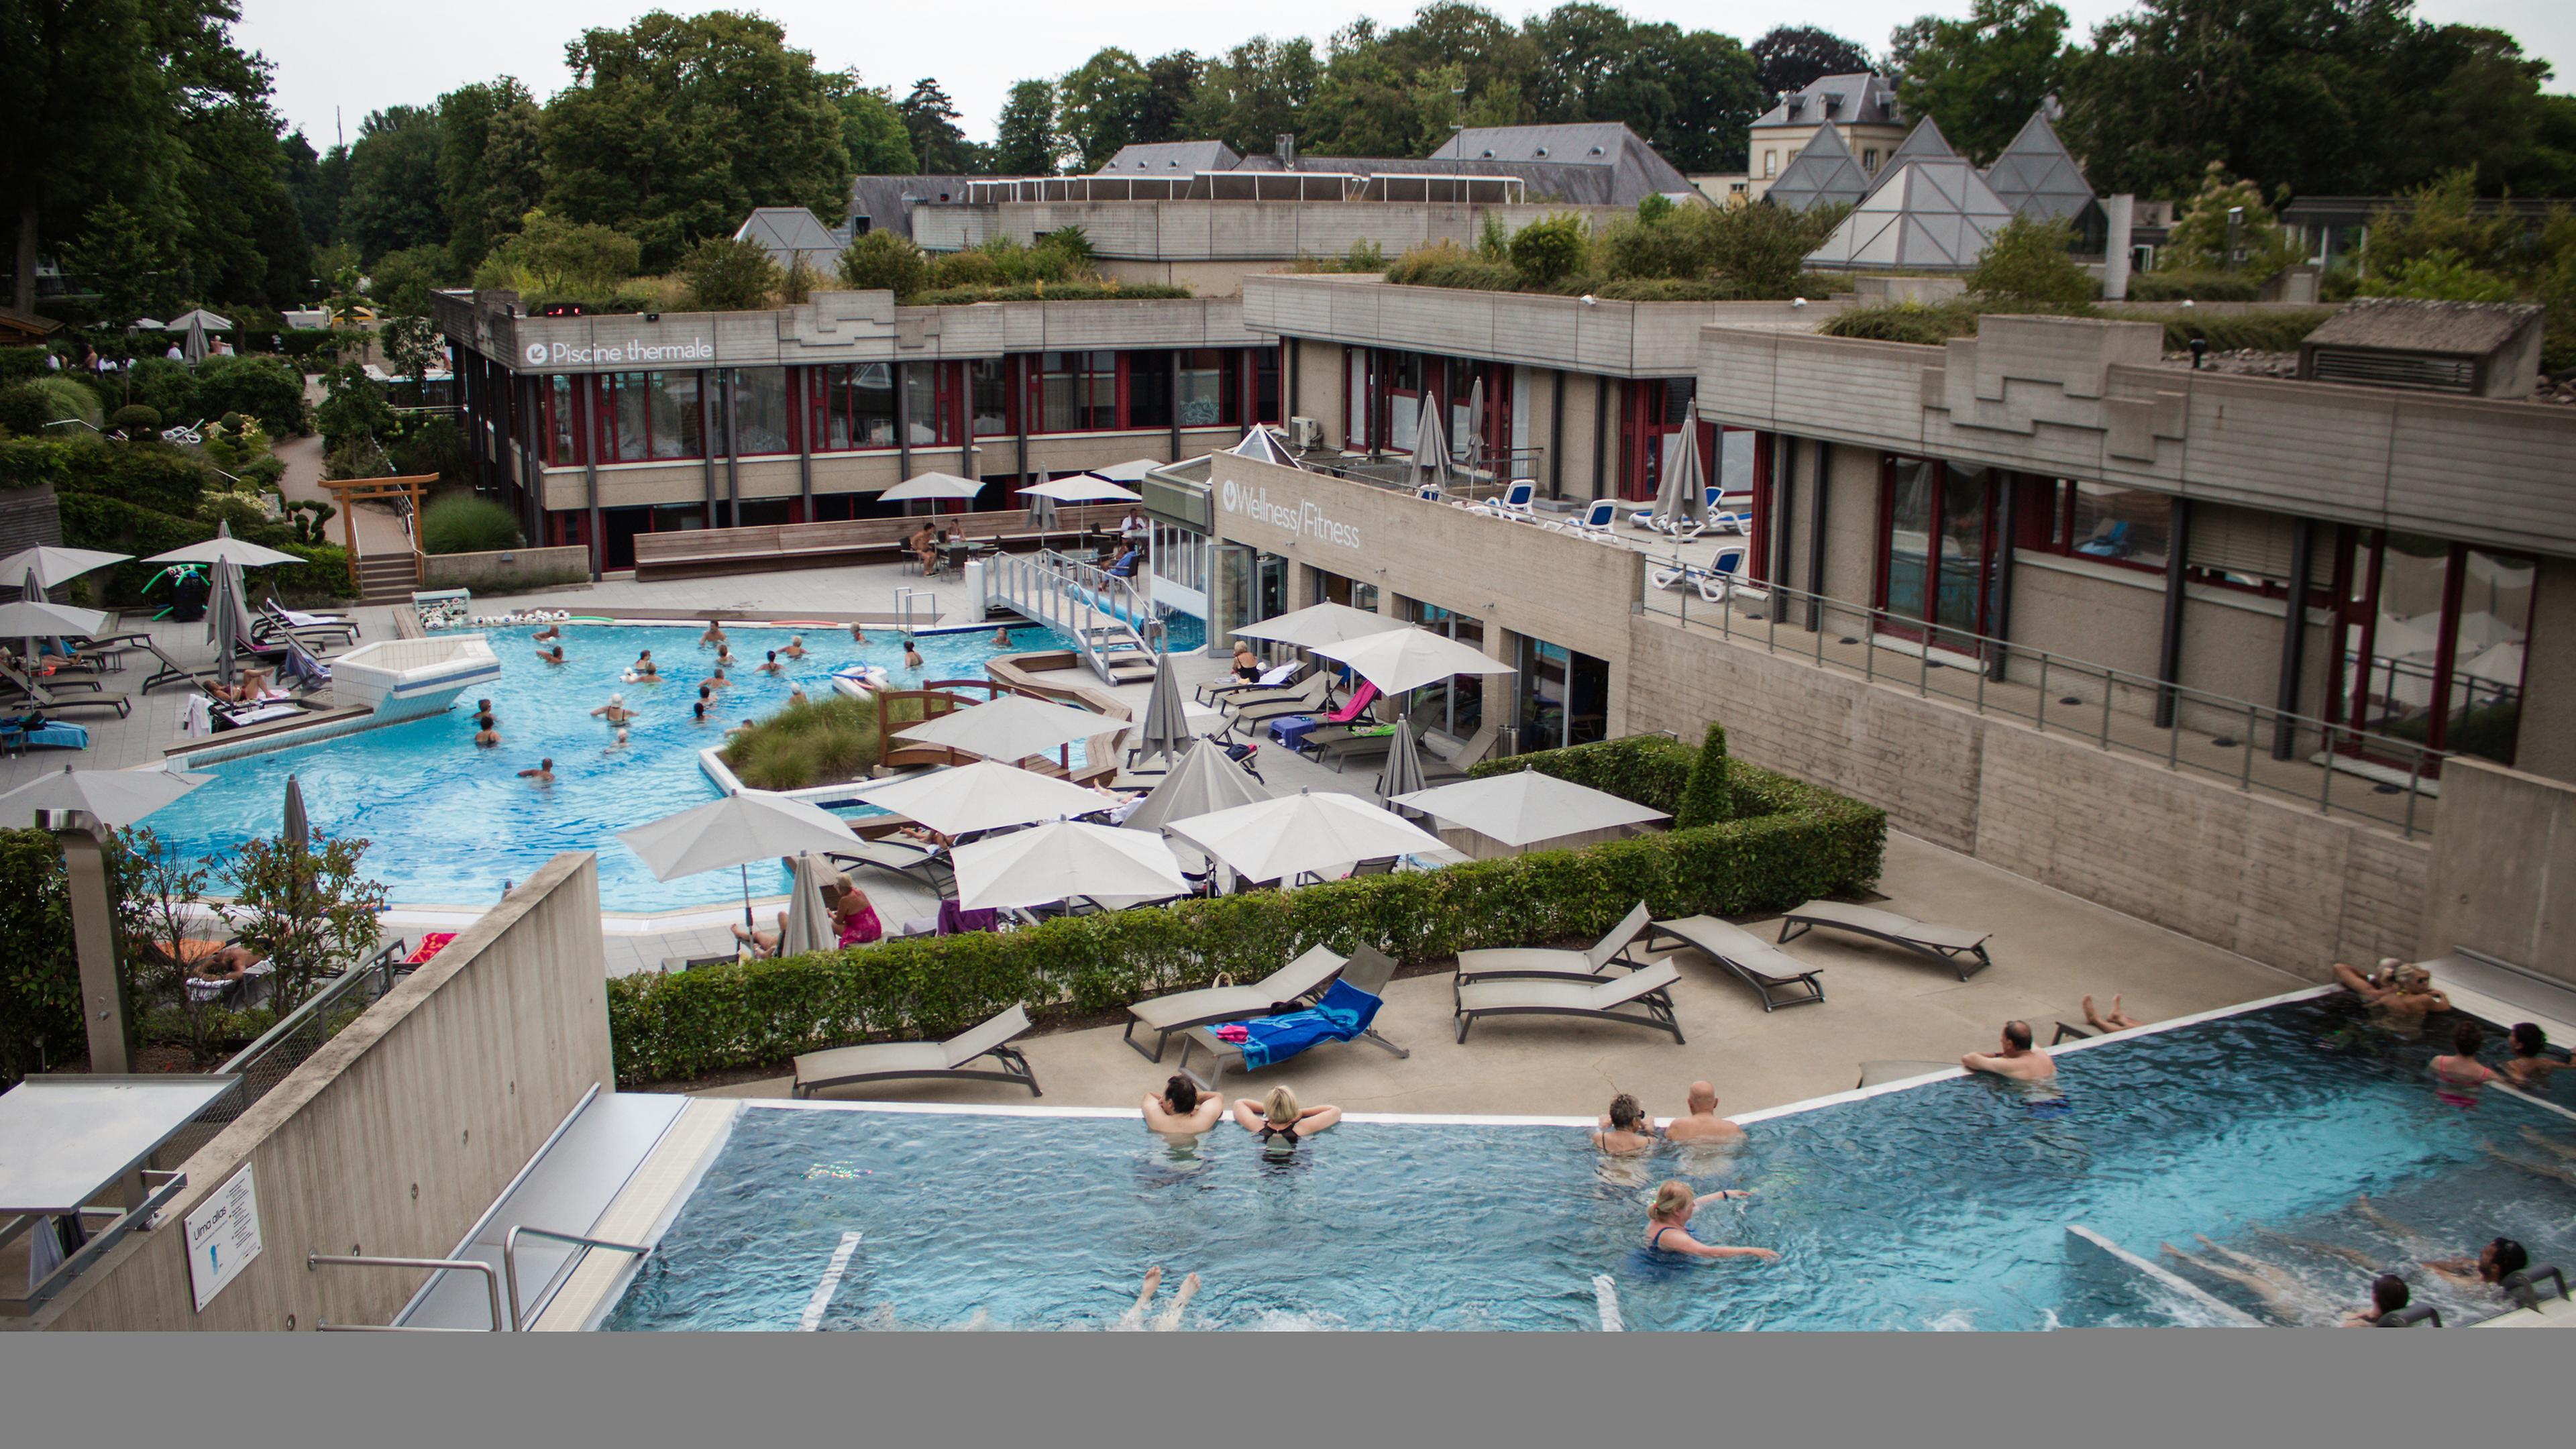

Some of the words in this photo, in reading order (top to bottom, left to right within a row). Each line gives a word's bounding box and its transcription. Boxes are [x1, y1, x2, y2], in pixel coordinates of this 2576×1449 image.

[553, 343, 622, 363] Piscine
[627, 337, 712, 360] thermale
[1236, 484, 1359, 548] Wellness/Fitness
